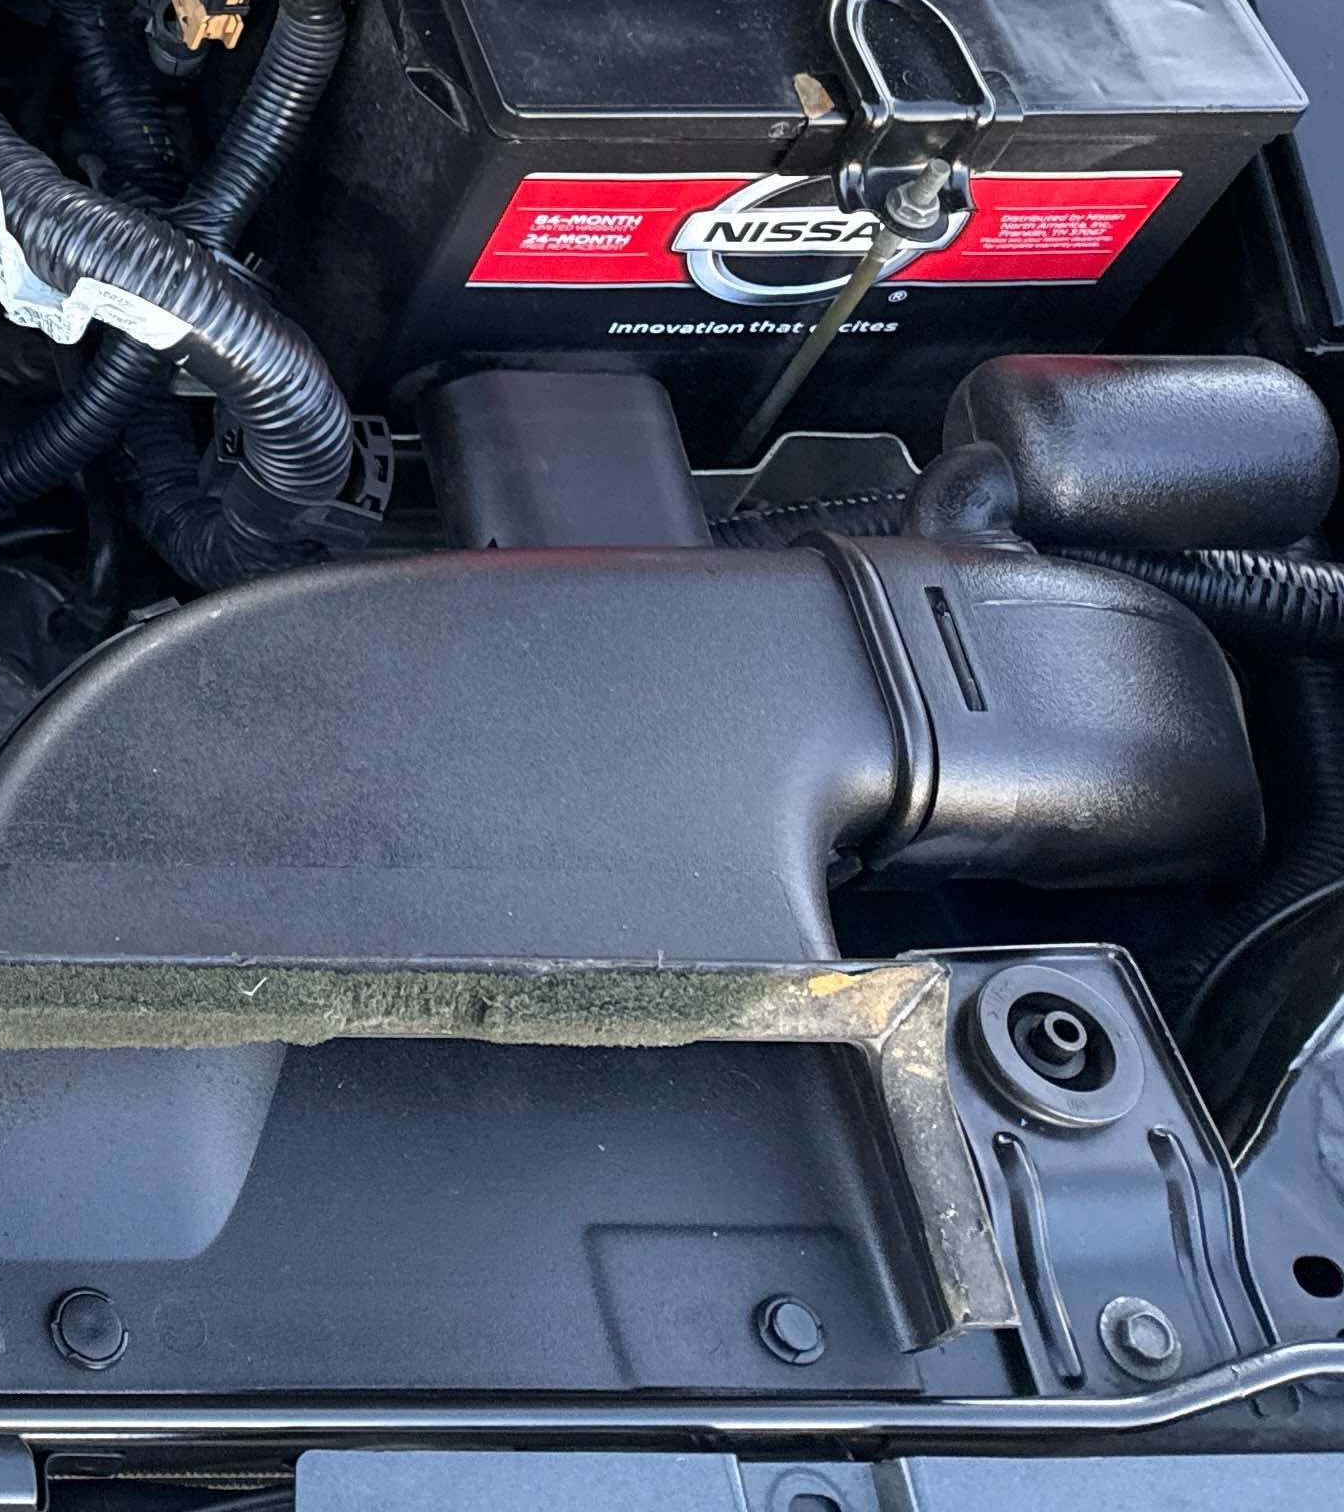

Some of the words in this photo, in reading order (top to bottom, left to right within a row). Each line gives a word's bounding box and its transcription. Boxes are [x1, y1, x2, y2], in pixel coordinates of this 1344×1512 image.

[534, 215, 644, 226] 84-MONTH
[703, 221, 885, 243] NISSA
[522, 233, 632, 245] 24-MONTH
[608, 321, 746, 335] Innovation
[749, 320, 802, 335] that
[809, 321, 899, 335] cites
